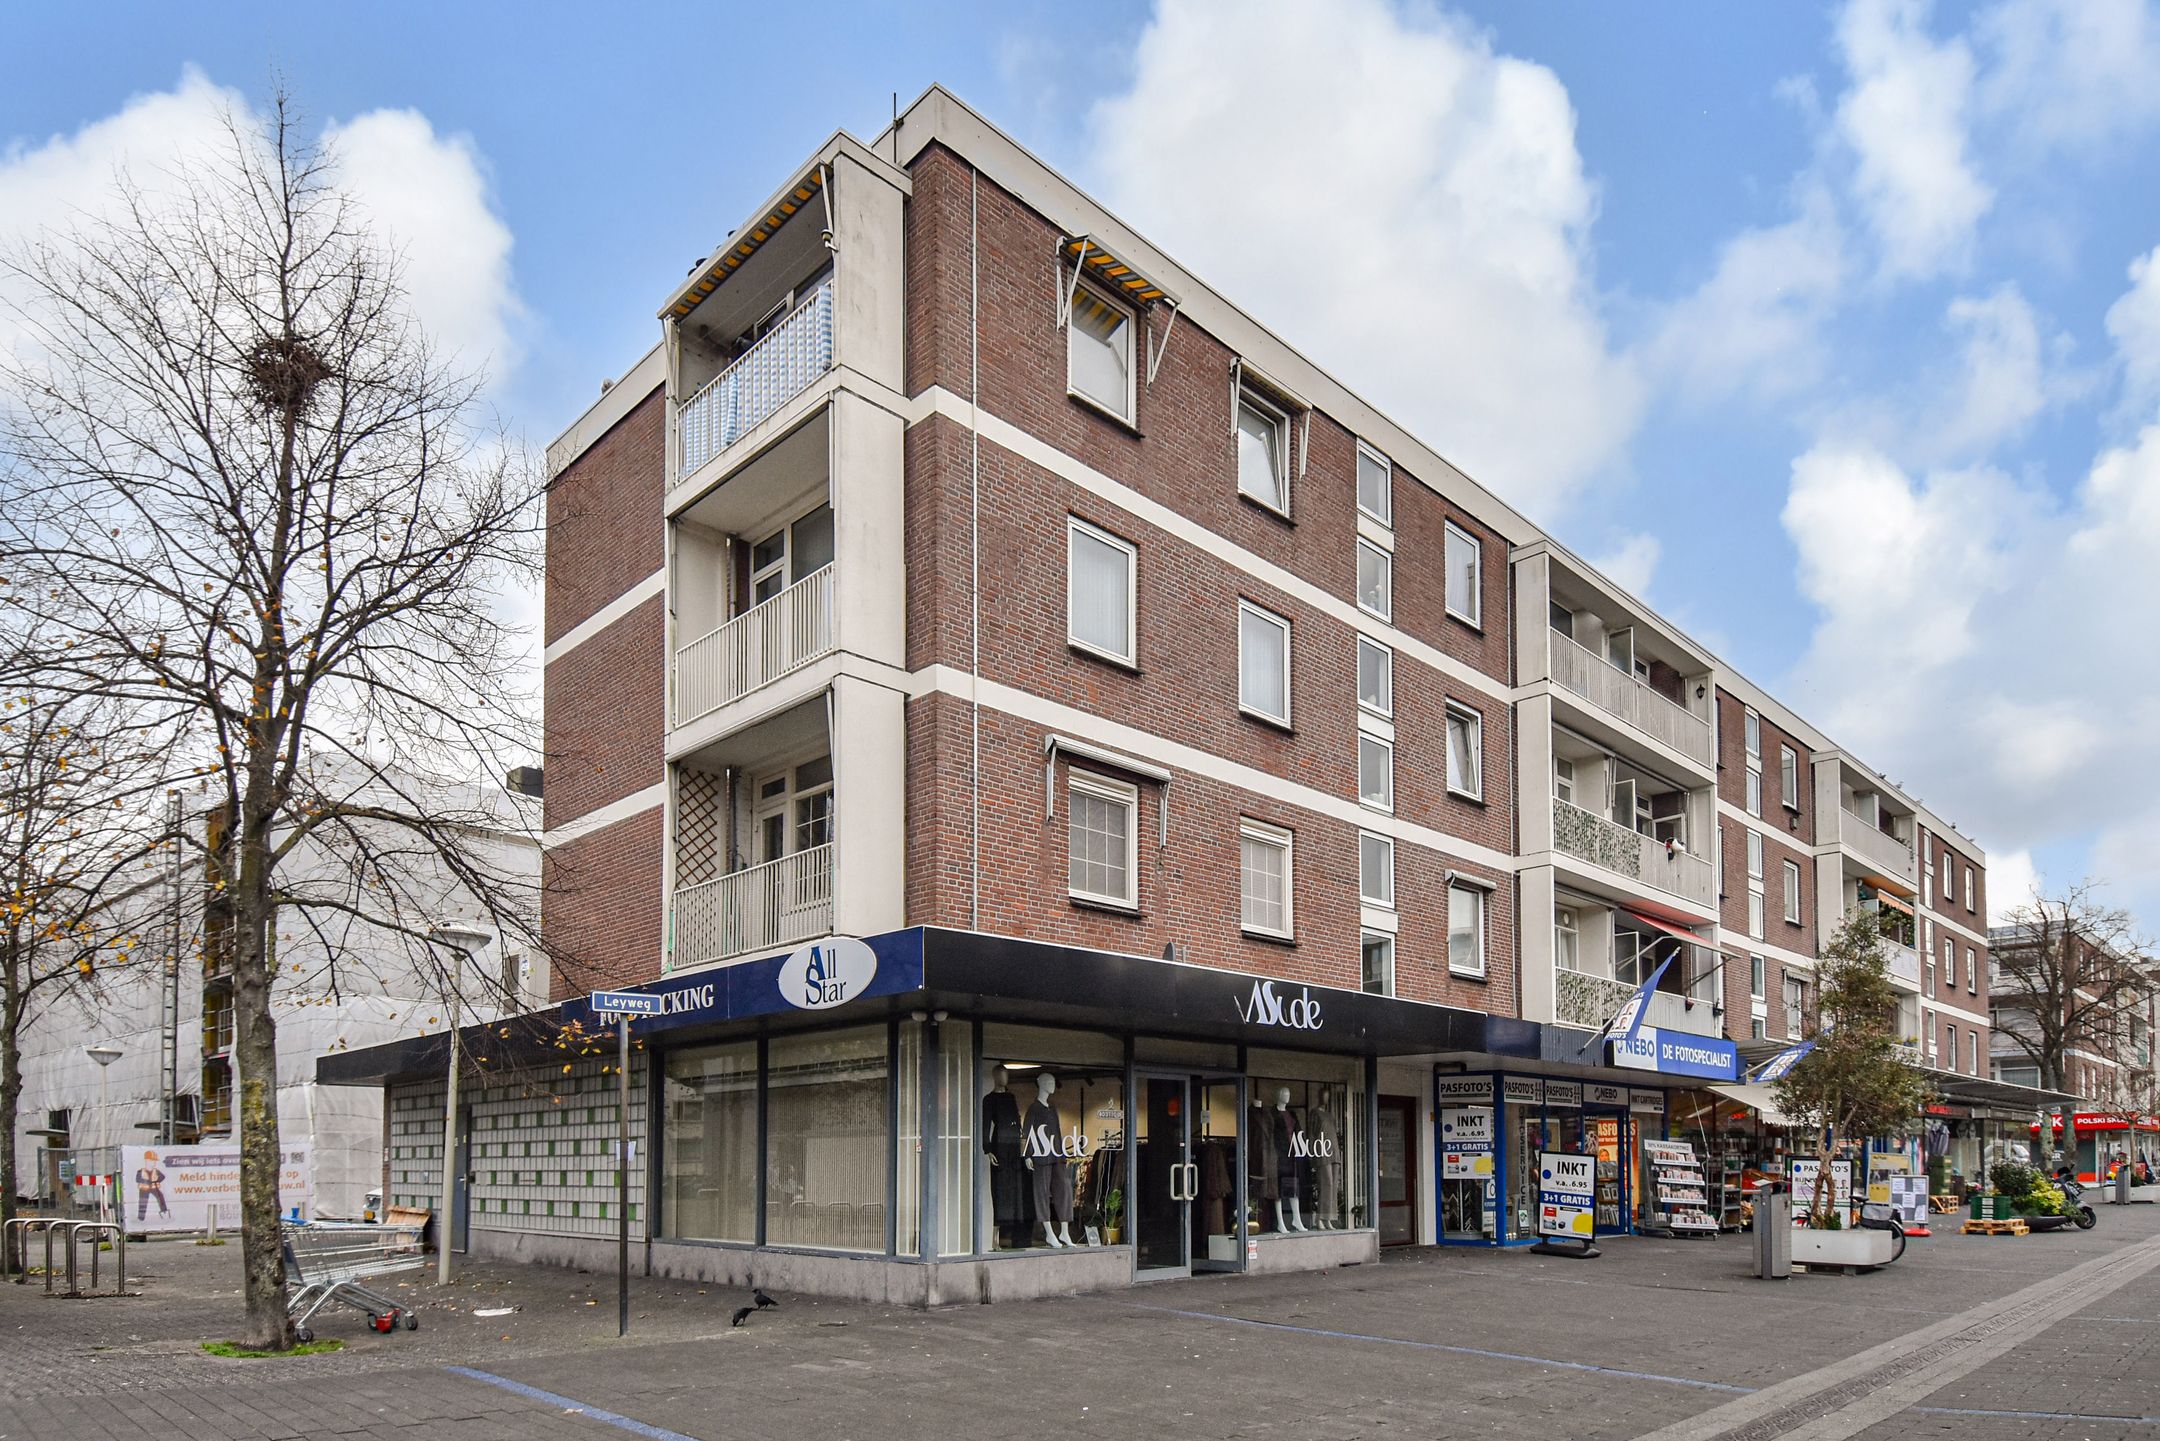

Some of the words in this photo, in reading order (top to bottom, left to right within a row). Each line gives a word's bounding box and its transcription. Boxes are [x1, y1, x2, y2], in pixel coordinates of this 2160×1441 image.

[806, 945, 837, 981] All
[805, 964, 847, 1006] Star
[604, 995, 651, 1012] Leyweg
[1625, 1037, 1655, 1058] NEBO
[1662, 1043, 1674, 1060] DE
[1675, 1046, 1732, 1068] FOTOSPECIALIST
[1440, 1082, 1493, 1093] PASFOTO'S
[1504, 1081, 1534, 1094] PASFOTO'S
[1546, 1085, 1574, 1098] PASFOTO'S
[1600, 1087, 1618, 1099] NEBO
[1456, 1115, 1484, 1127] INKT
[1446, 1143, 1460, 1151] 3+1
[1461, 1143, 1489, 1151] GRATIS
[1557, 1161, 1587, 1176] INKT
[1803, 1165, 1849, 1173] PASTO'S
[180, 1173, 206, 1182] Meld
[209, 1171, 241, 1181] hinde
[1544, 1193, 1558, 1203] 3+1
[1560, 1195, 1591, 1206] GRATIS
